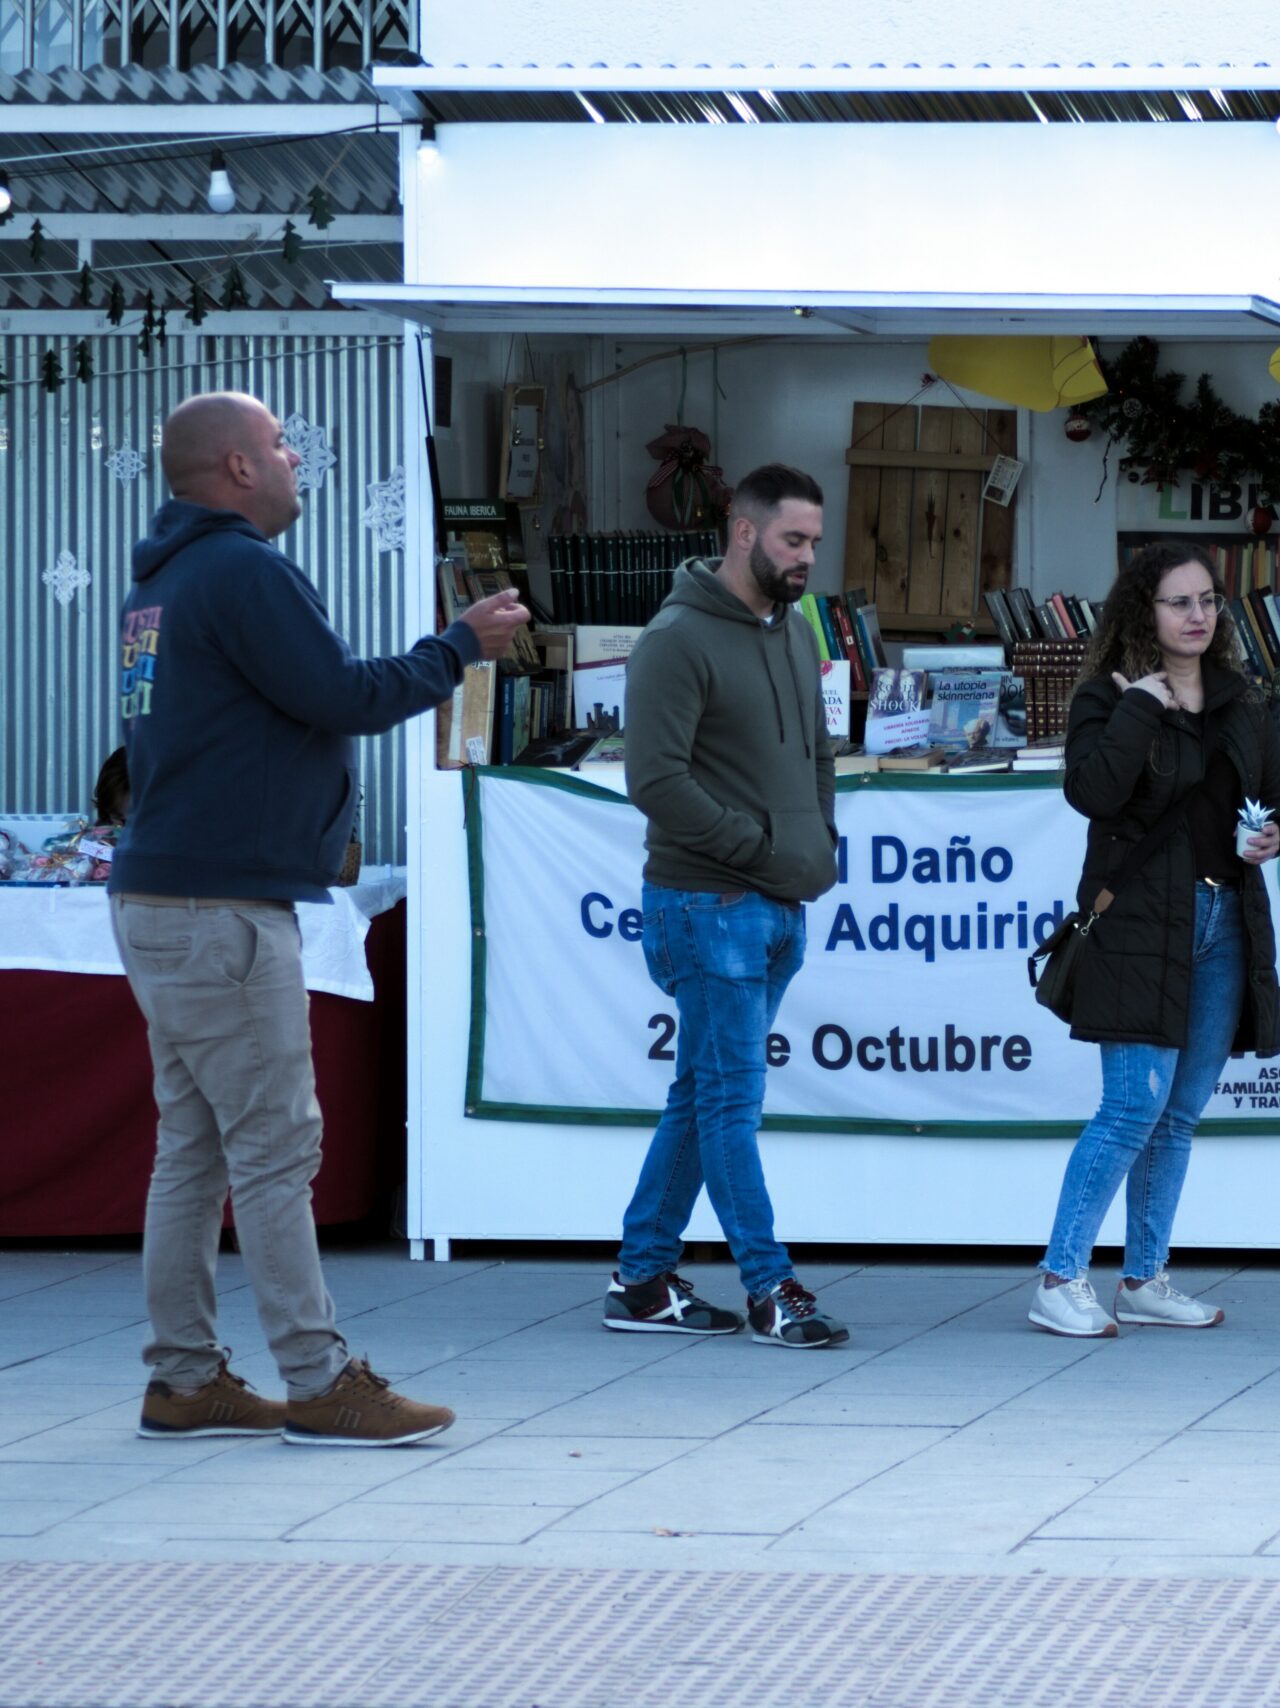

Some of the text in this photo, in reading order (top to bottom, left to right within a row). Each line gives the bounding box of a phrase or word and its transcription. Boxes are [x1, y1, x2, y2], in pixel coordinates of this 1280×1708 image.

[444, 505, 497, 516] FAUNA IBERICA
[938, 680, 951, 691] La
[936, 690, 995, 701] skinneriana
[870, 699, 919, 713] SHOCK
[872, 835, 1014, 884] Daño
[648, 1012, 676, 1061] 2
[811, 1023, 1033, 1072] Octubre
[1234, 1096, 1243, 1109] Y
